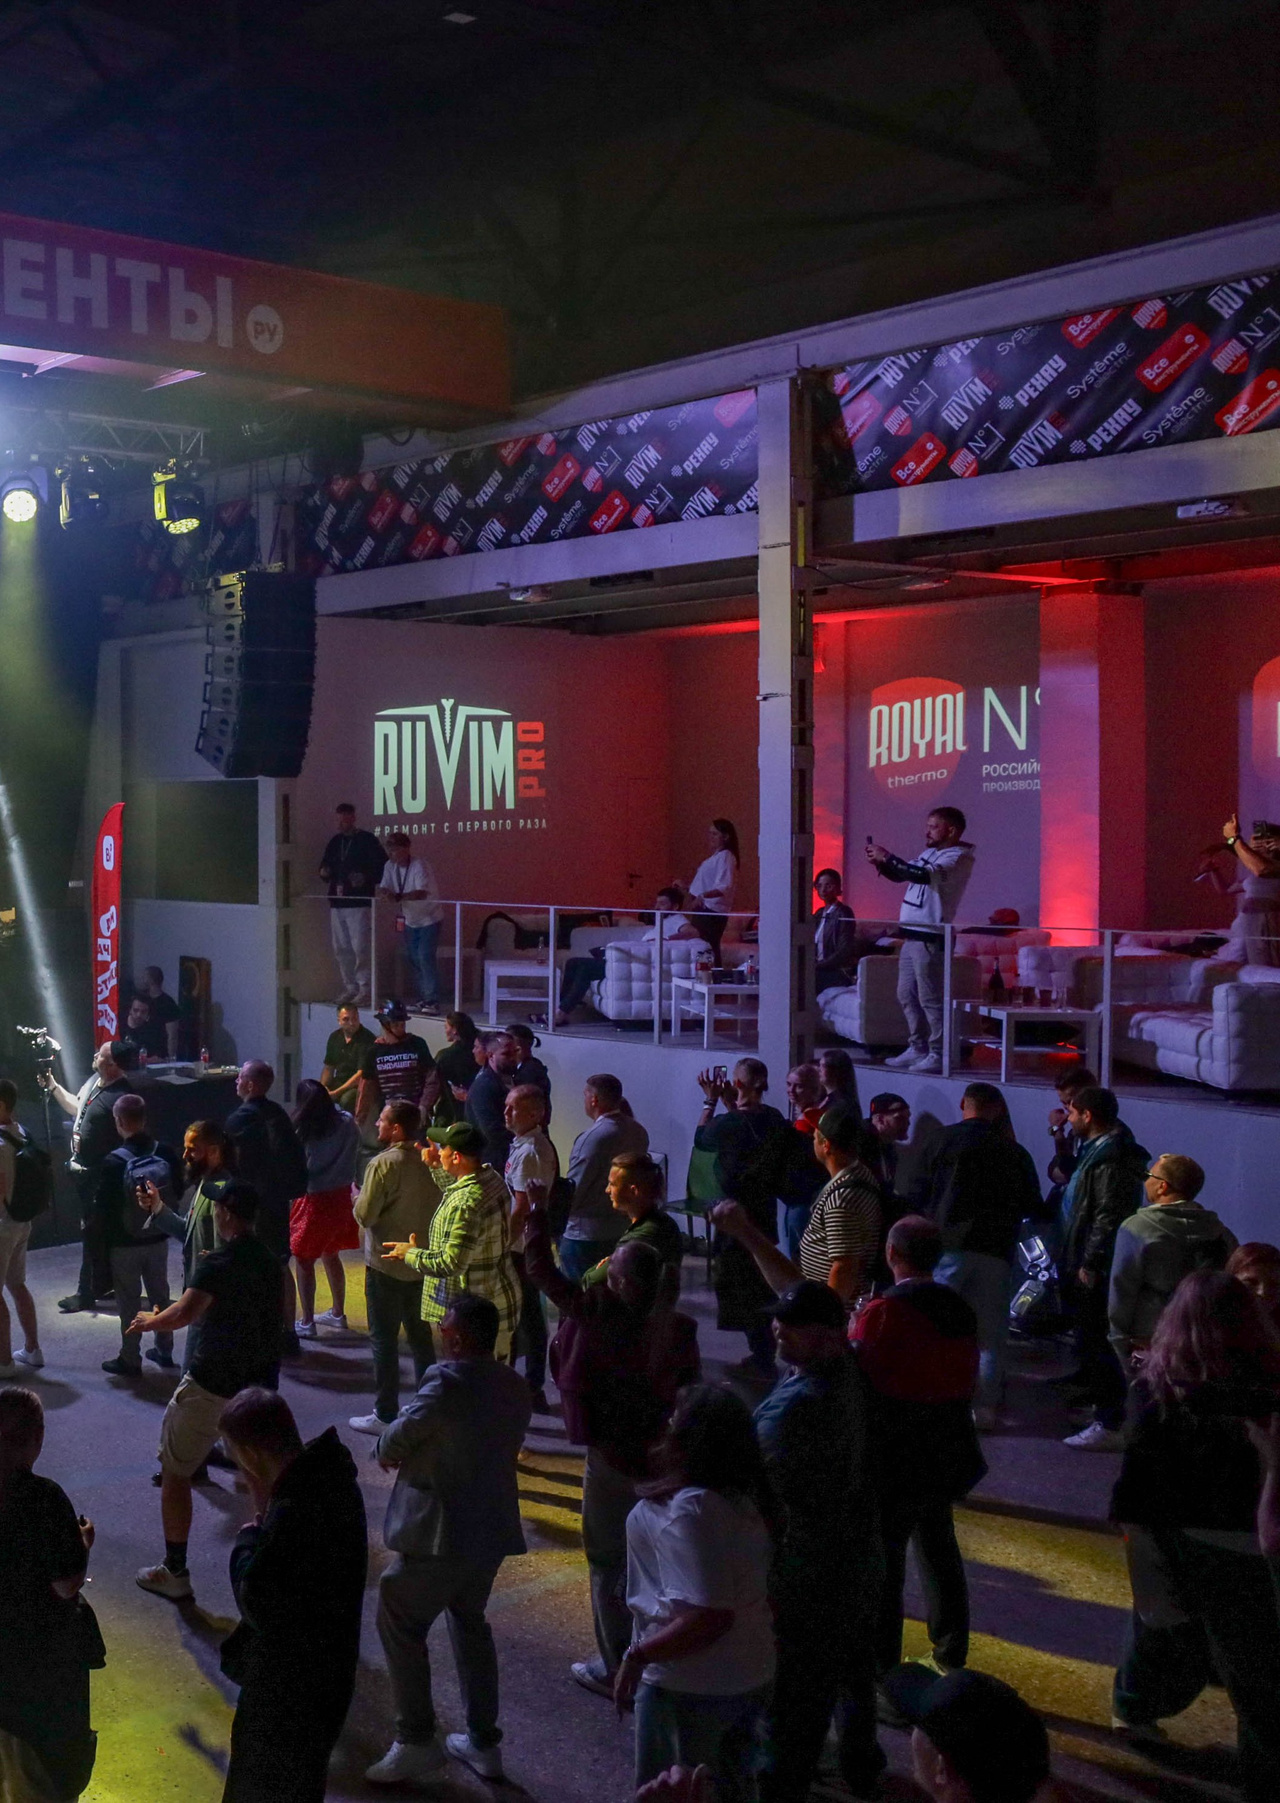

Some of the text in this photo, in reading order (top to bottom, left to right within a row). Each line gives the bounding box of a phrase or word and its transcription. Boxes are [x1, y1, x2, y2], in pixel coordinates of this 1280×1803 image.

[1069, 314, 1093, 336] Все
[1143, 358, 1170, 380] Все
[940, 376, 993, 431] RUVIM
[1222, 404, 1251, 426] Все
[624, 444, 662, 490] RUVIM
[896, 461, 916, 480] Все
[432, 482, 462, 523] RUVIM
[869, 691, 967, 768] ROYAL
[374, 704, 516, 815] RUVIM
[517, 721, 546, 798] PRO
[887, 768, 948, 789] thermo
[457, 820, 512, 833] ПЕРВОГО
[519, 818, 548, 830] РАЗА
